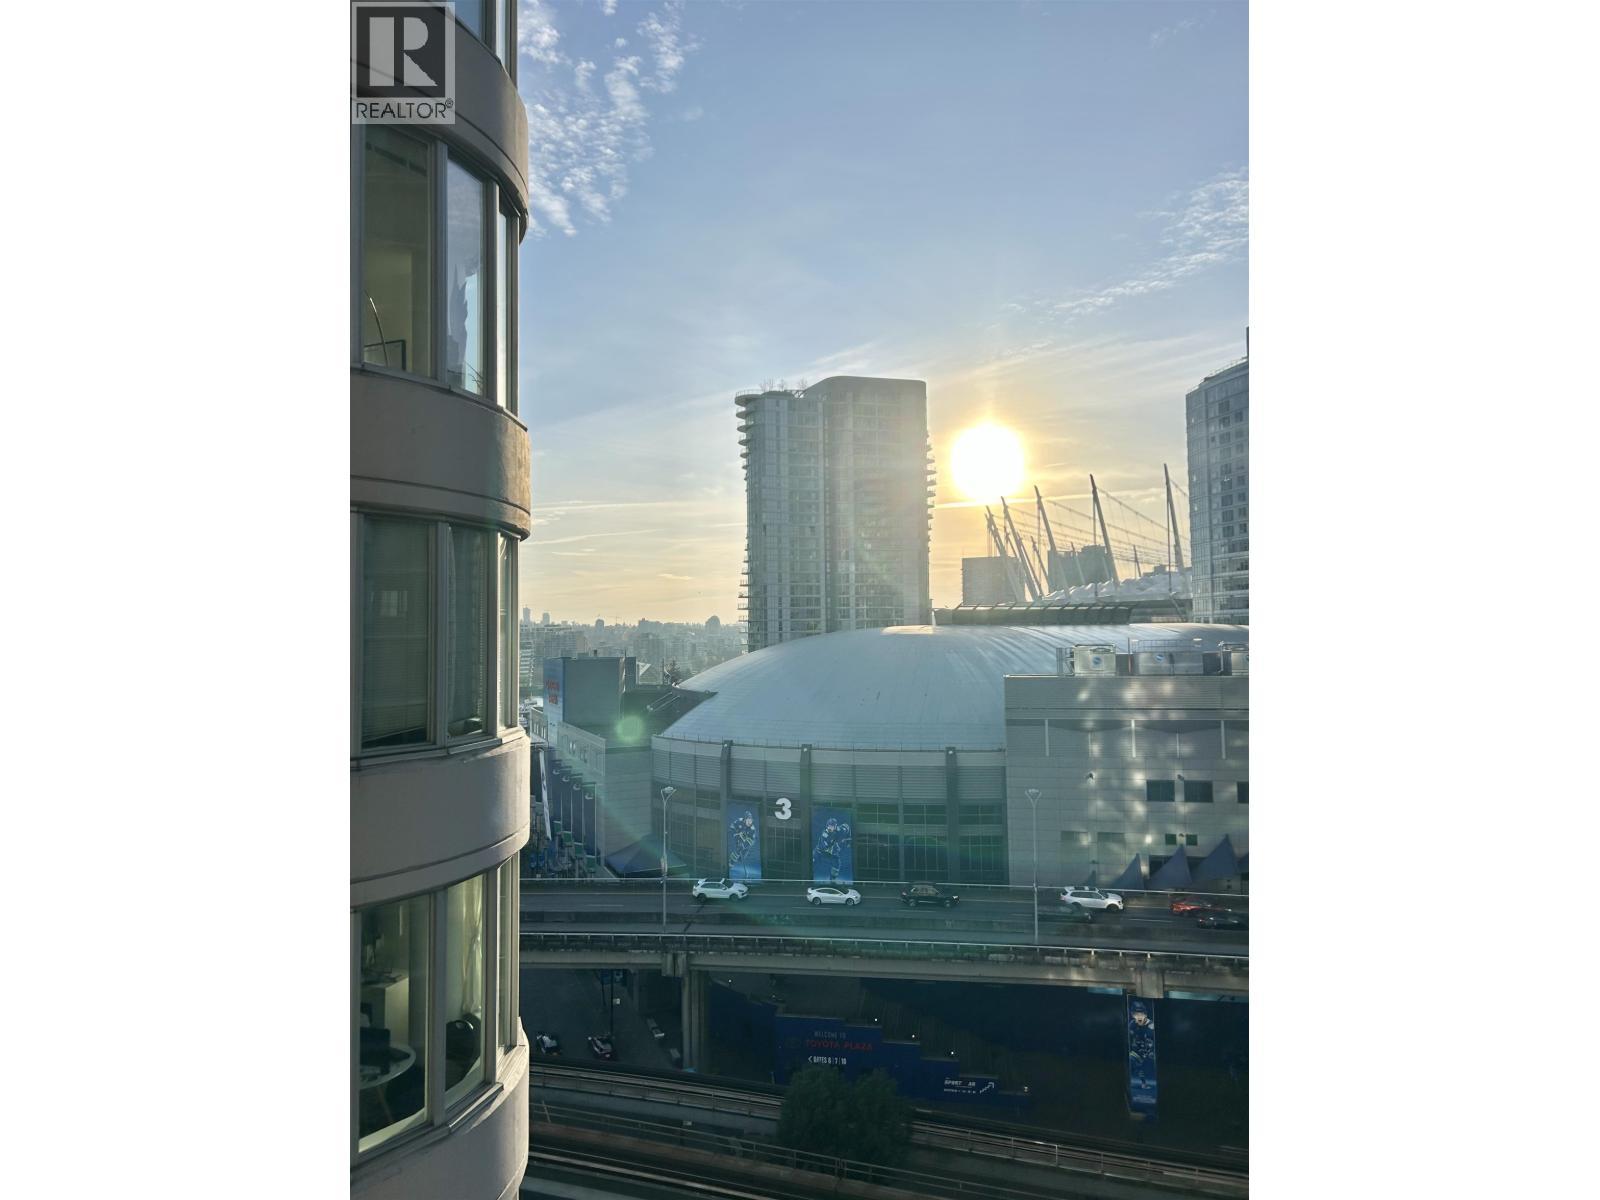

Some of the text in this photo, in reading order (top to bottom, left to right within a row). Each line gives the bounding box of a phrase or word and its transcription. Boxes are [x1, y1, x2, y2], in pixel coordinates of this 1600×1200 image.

[774, 797, 792, 820] 3
[814, 1031, 838, 1040] WELCOME
[806, 1040, 872, 1051] TOYOTA PLAZA
